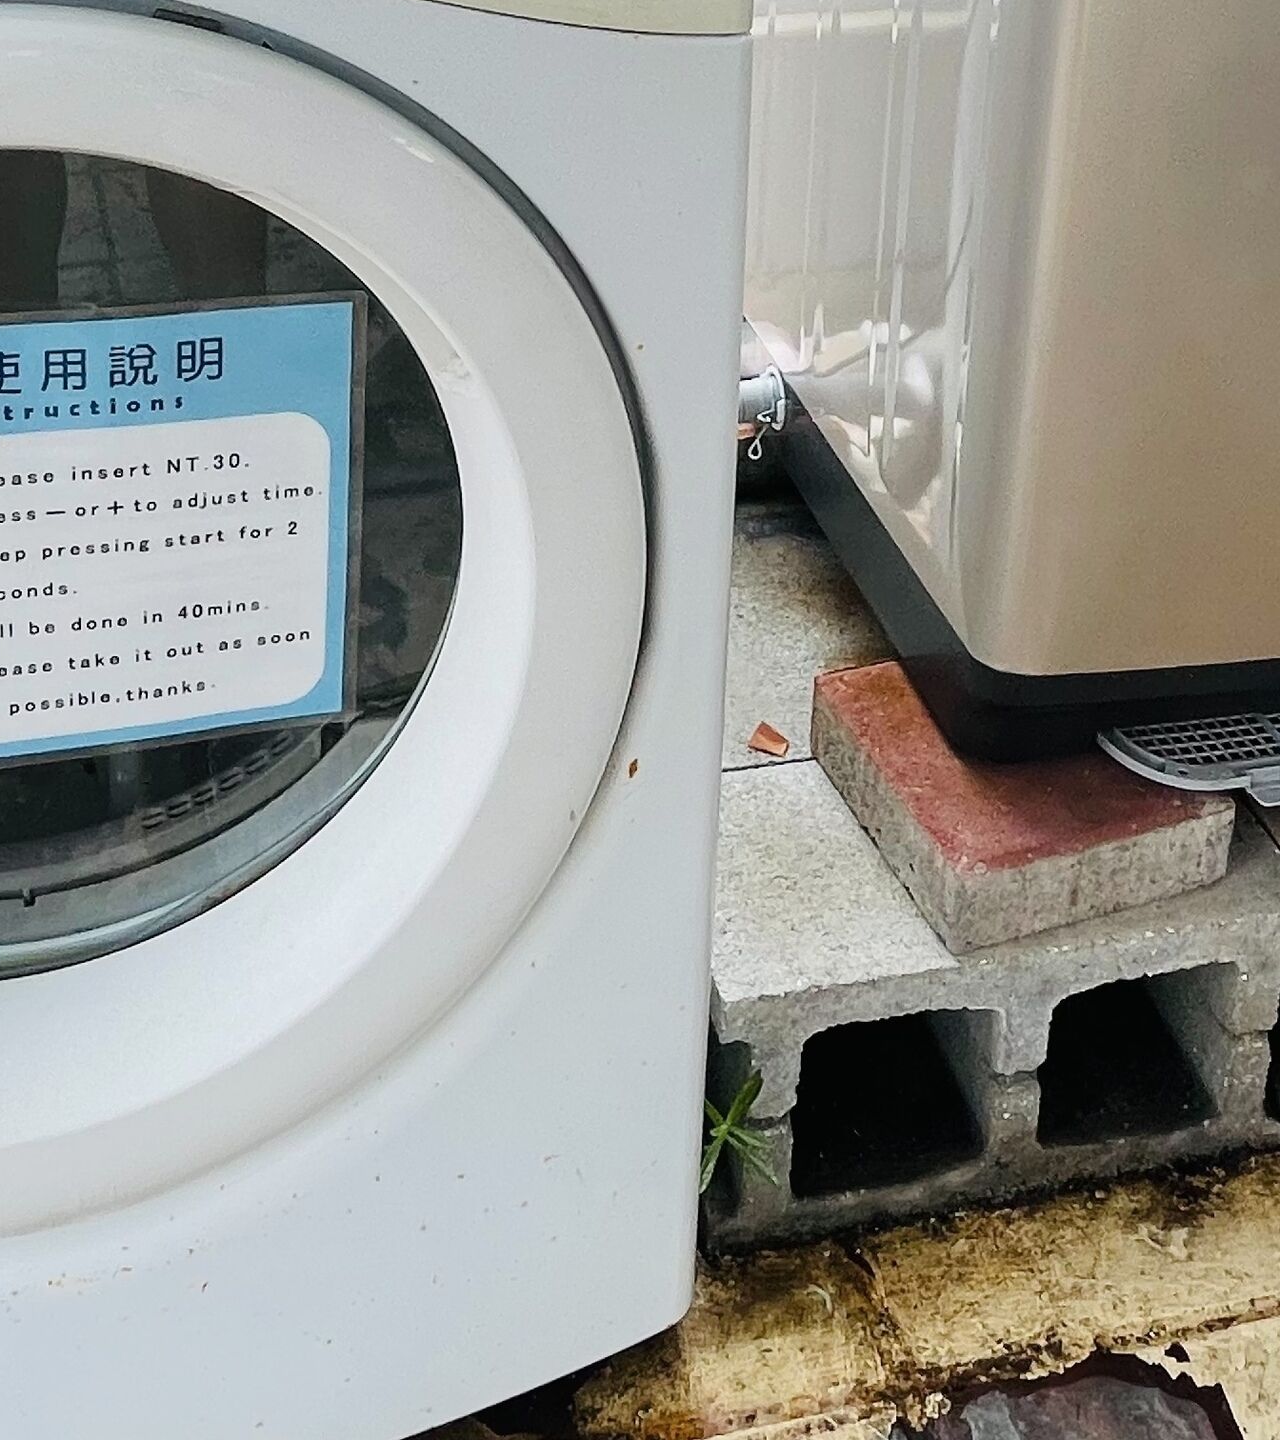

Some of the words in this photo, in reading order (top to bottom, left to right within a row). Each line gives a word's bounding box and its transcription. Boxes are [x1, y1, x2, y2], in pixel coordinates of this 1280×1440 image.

[71, 461, 151, 481] insert
[172, 490, 250, 511] adjust
[263, 483, 323, 500] time.
[42, 535, 151, 561] pressing
[165, 529, 226, 549] start
[239, 524, 274, 540] for
[287, 521, 299, 536] 2
[29, 620, 56, 635] be
[71, 614, 129, 632] done
[143, 610, 163, 625] in
[68, 652, 120, 670] take
[135, 648, 152, 663] it
[166, 641, 205, 658] out
[219, 637, 243, 652] as
[257, 628, 312, 646] soon
